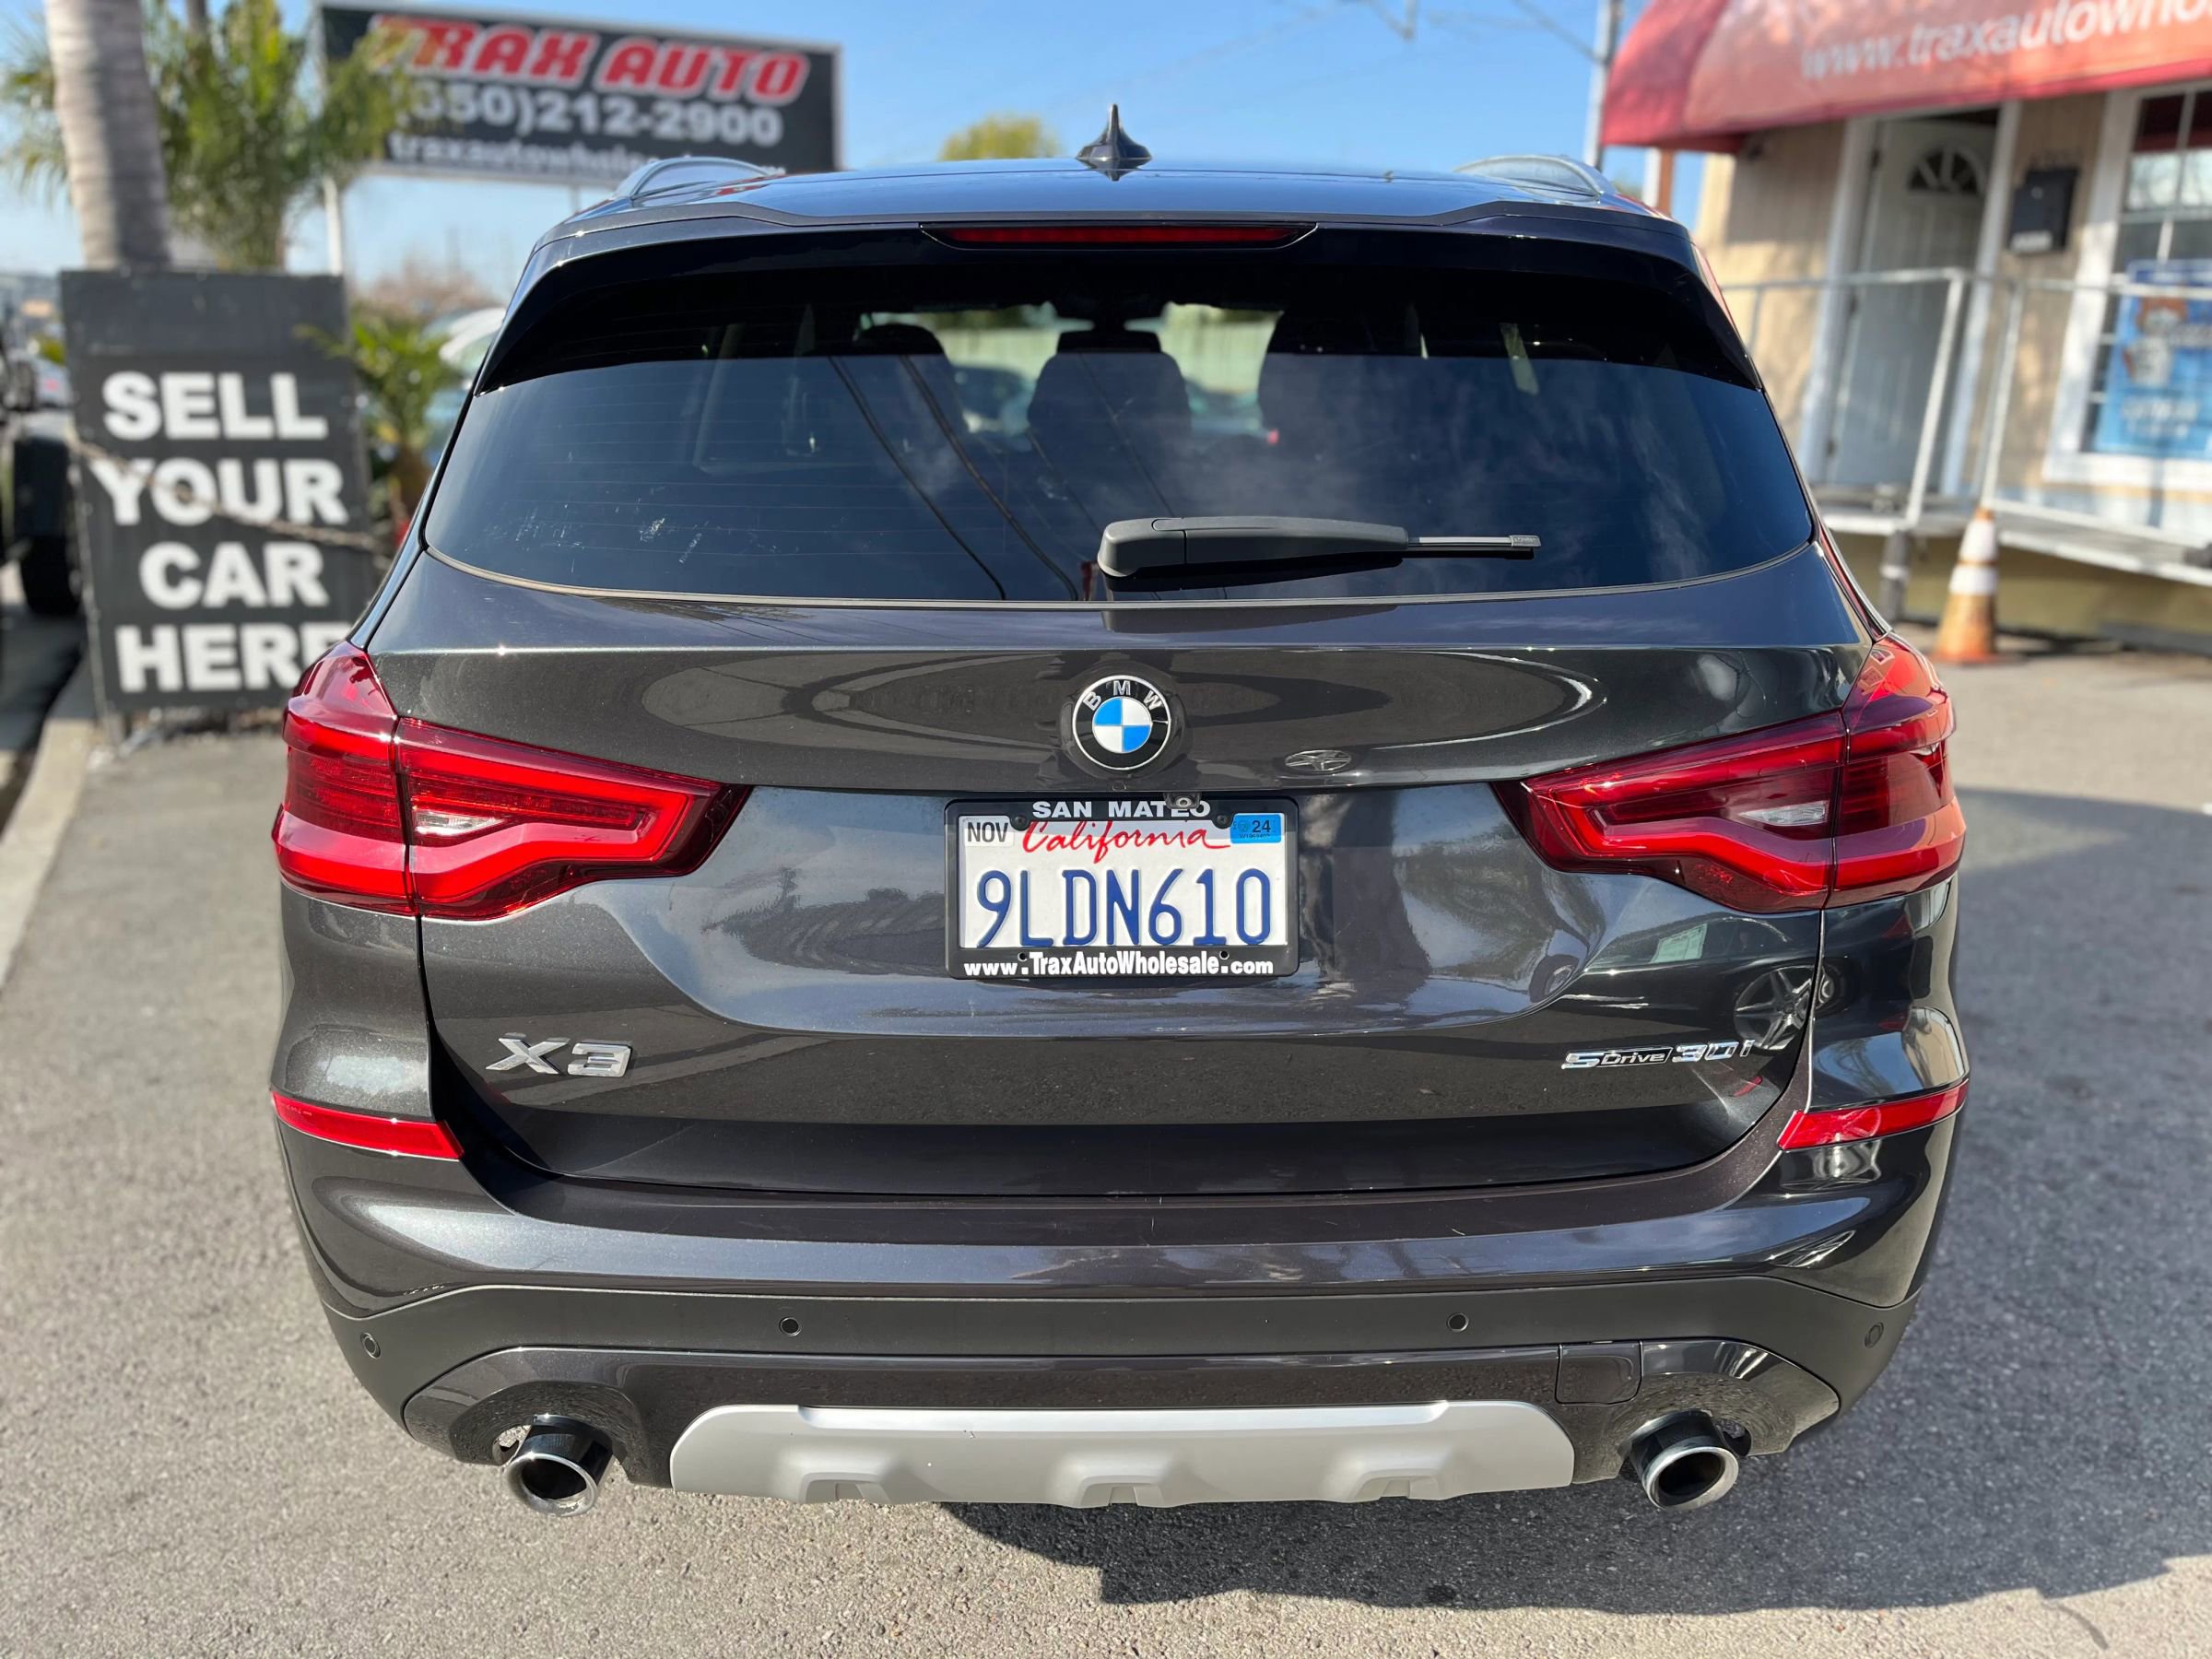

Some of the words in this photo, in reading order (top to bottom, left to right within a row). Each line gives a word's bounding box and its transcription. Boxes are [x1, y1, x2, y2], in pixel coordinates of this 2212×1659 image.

[371, 16, 599, 85] TRAX
[594, 37, 808, 102] AUTO
[1802, 0, 2212, 79] www.traxautowho
[103, 371, 328, 440] SELL
[92, 458, 349, 525] YOUR
[139, 542, 329, 608] CAR
[1082, 680, 1162, 712] BMW
[967, 821, 1008, 842] NOV
[1032, 800, 1092, 818] SAN
[1252, 819, 1271, 833] 24
[1022, 820, 1230, 865] California
[975, 868, 1271, 949] 9LDN610
[964, 951, 1274, 976] www.TraxAutoWholesale.com
[486, 1037, 632, 1077] X3
